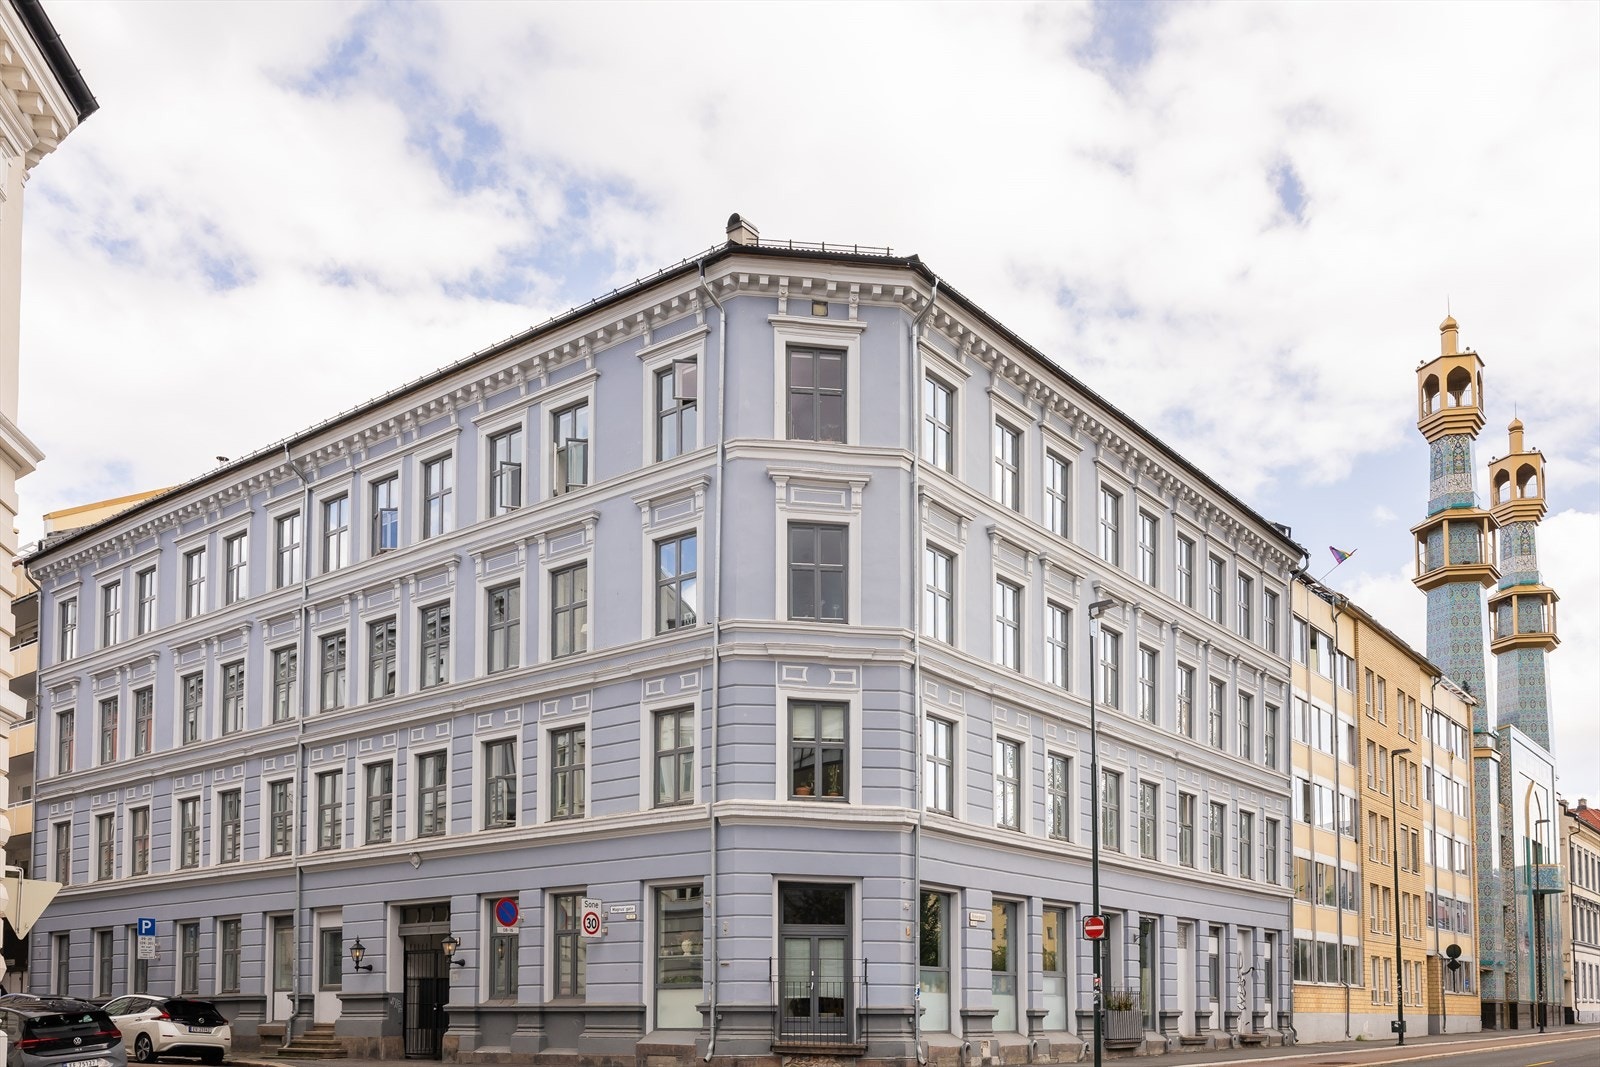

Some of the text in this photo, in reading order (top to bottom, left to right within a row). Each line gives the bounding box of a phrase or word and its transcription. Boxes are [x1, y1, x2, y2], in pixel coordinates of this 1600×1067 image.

[584, 900, 598, 908] Sone
[142, 920, 151, 934] P
[586, 918, 597, 929] 30
